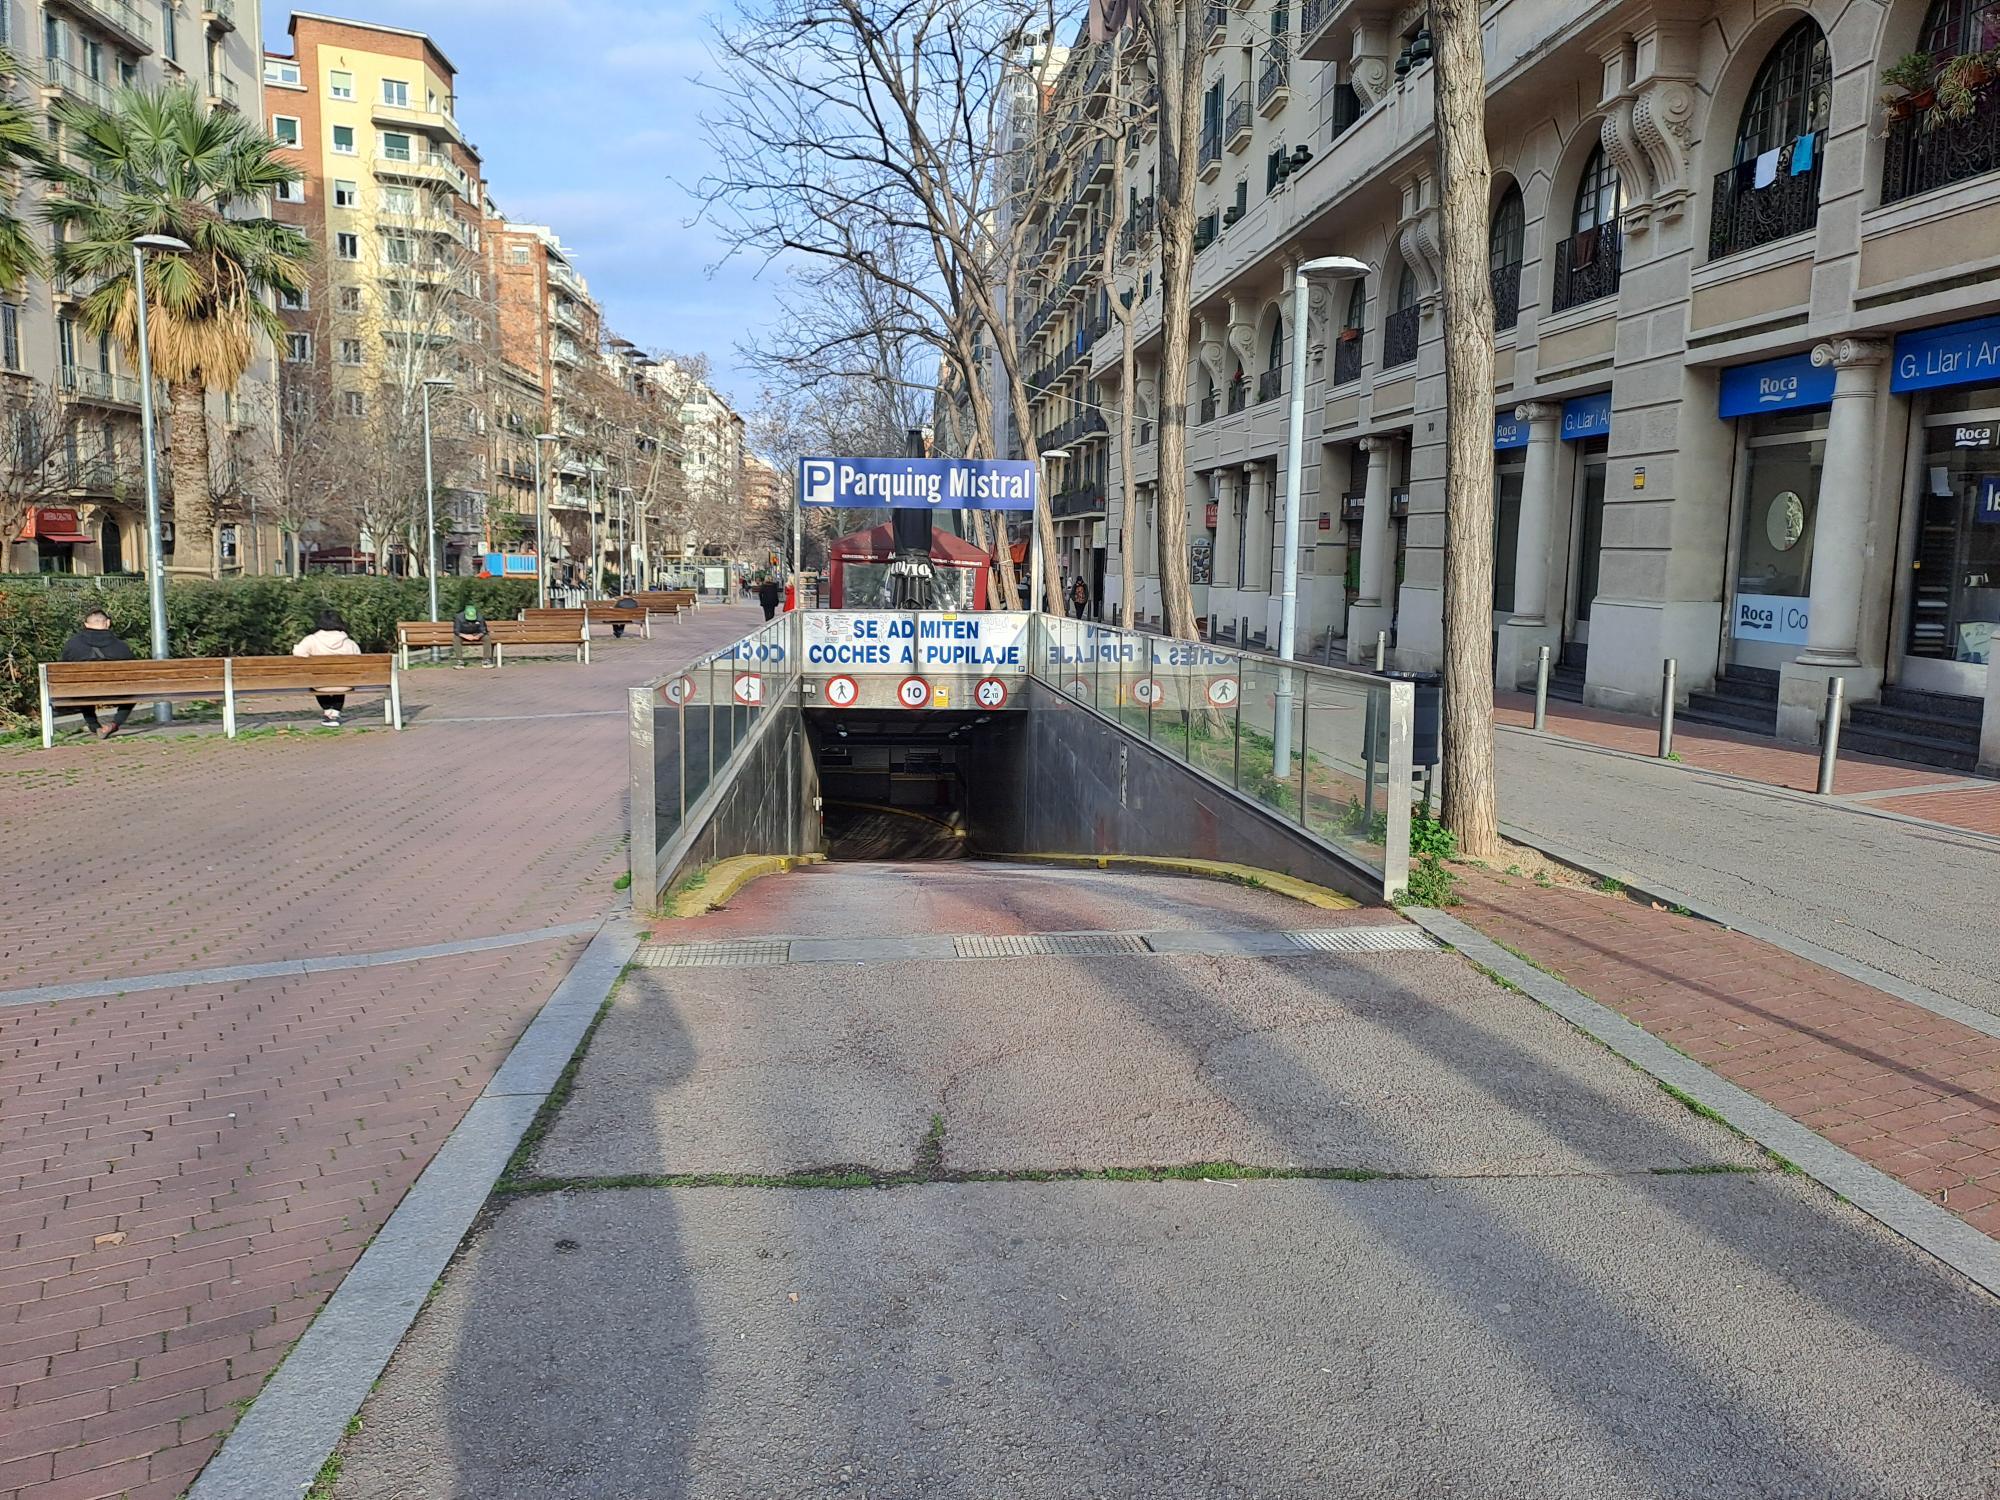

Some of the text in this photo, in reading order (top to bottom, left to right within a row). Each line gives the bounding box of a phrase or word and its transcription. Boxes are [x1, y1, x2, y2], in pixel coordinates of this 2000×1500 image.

[1900, 354, 1920, 379] G.
[1926, 349, 1962, 376] Llar
[1966, 344, 1972, 369] i
[1760, 377, 1797, 394] Roca
[1497, 424, 1517, 438] Roca
[1955, 427, 1990, 440] Roca
[807, 465, 1030, 503] P Parquing Mistral
[1741, 604, 1773, 622] Roca
[853, 619, 878, 639] SE
[808, 644, 1020, 665] COCHES A PUPILAJE
[906, 687, 922, 699] 10
